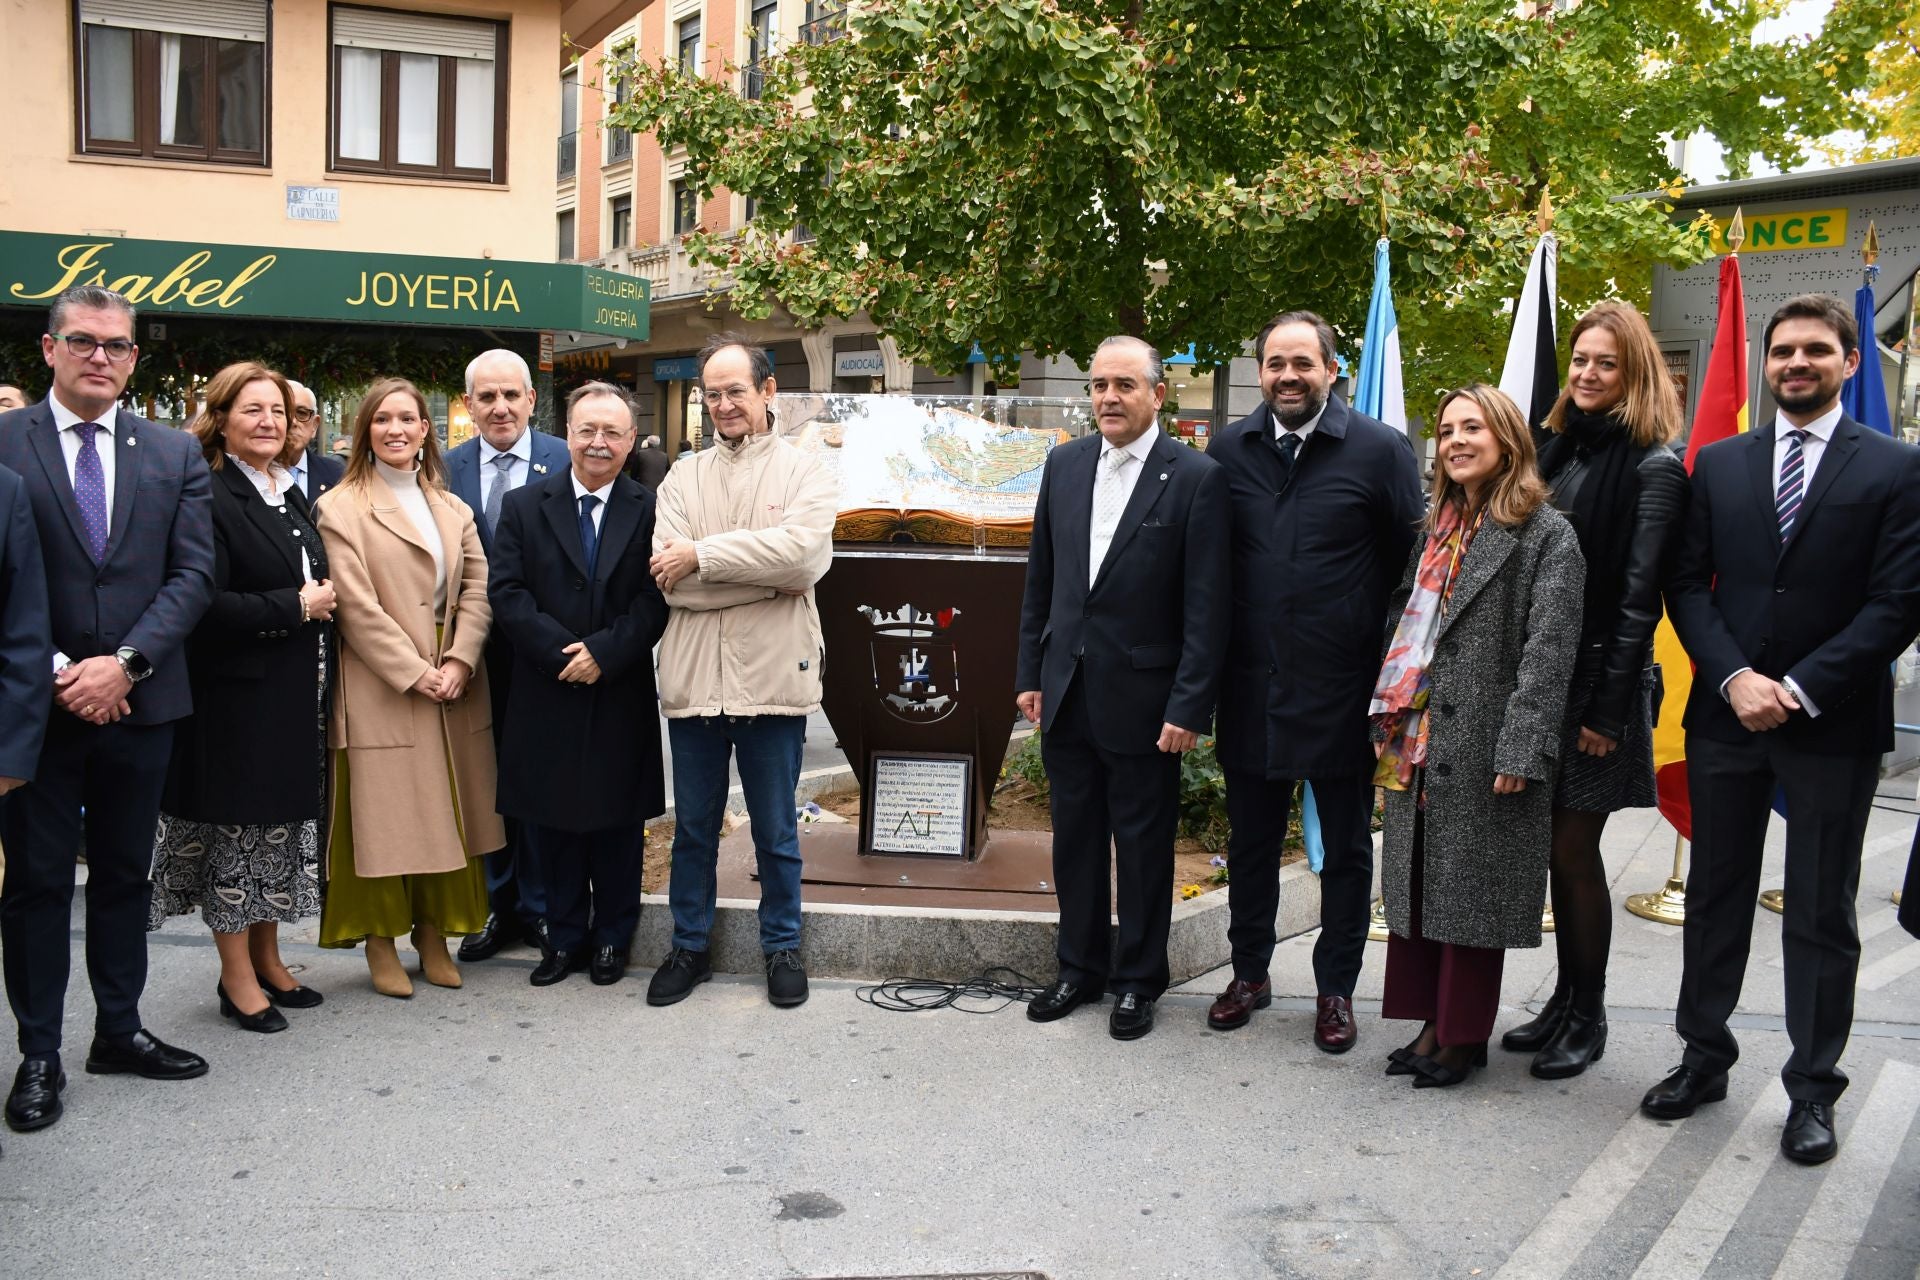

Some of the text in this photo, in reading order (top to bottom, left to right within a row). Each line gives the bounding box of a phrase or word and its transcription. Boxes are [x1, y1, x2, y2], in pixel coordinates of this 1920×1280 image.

[308, 189, 336, 203] CALLE
[10, 243, 521, 313] Isabel JOYERÍA
[587, 275, 645, 301] RELOJERÍA
[595, 307, 637, 329] JOYERÍA
[154, 326, 161, 338] 2
